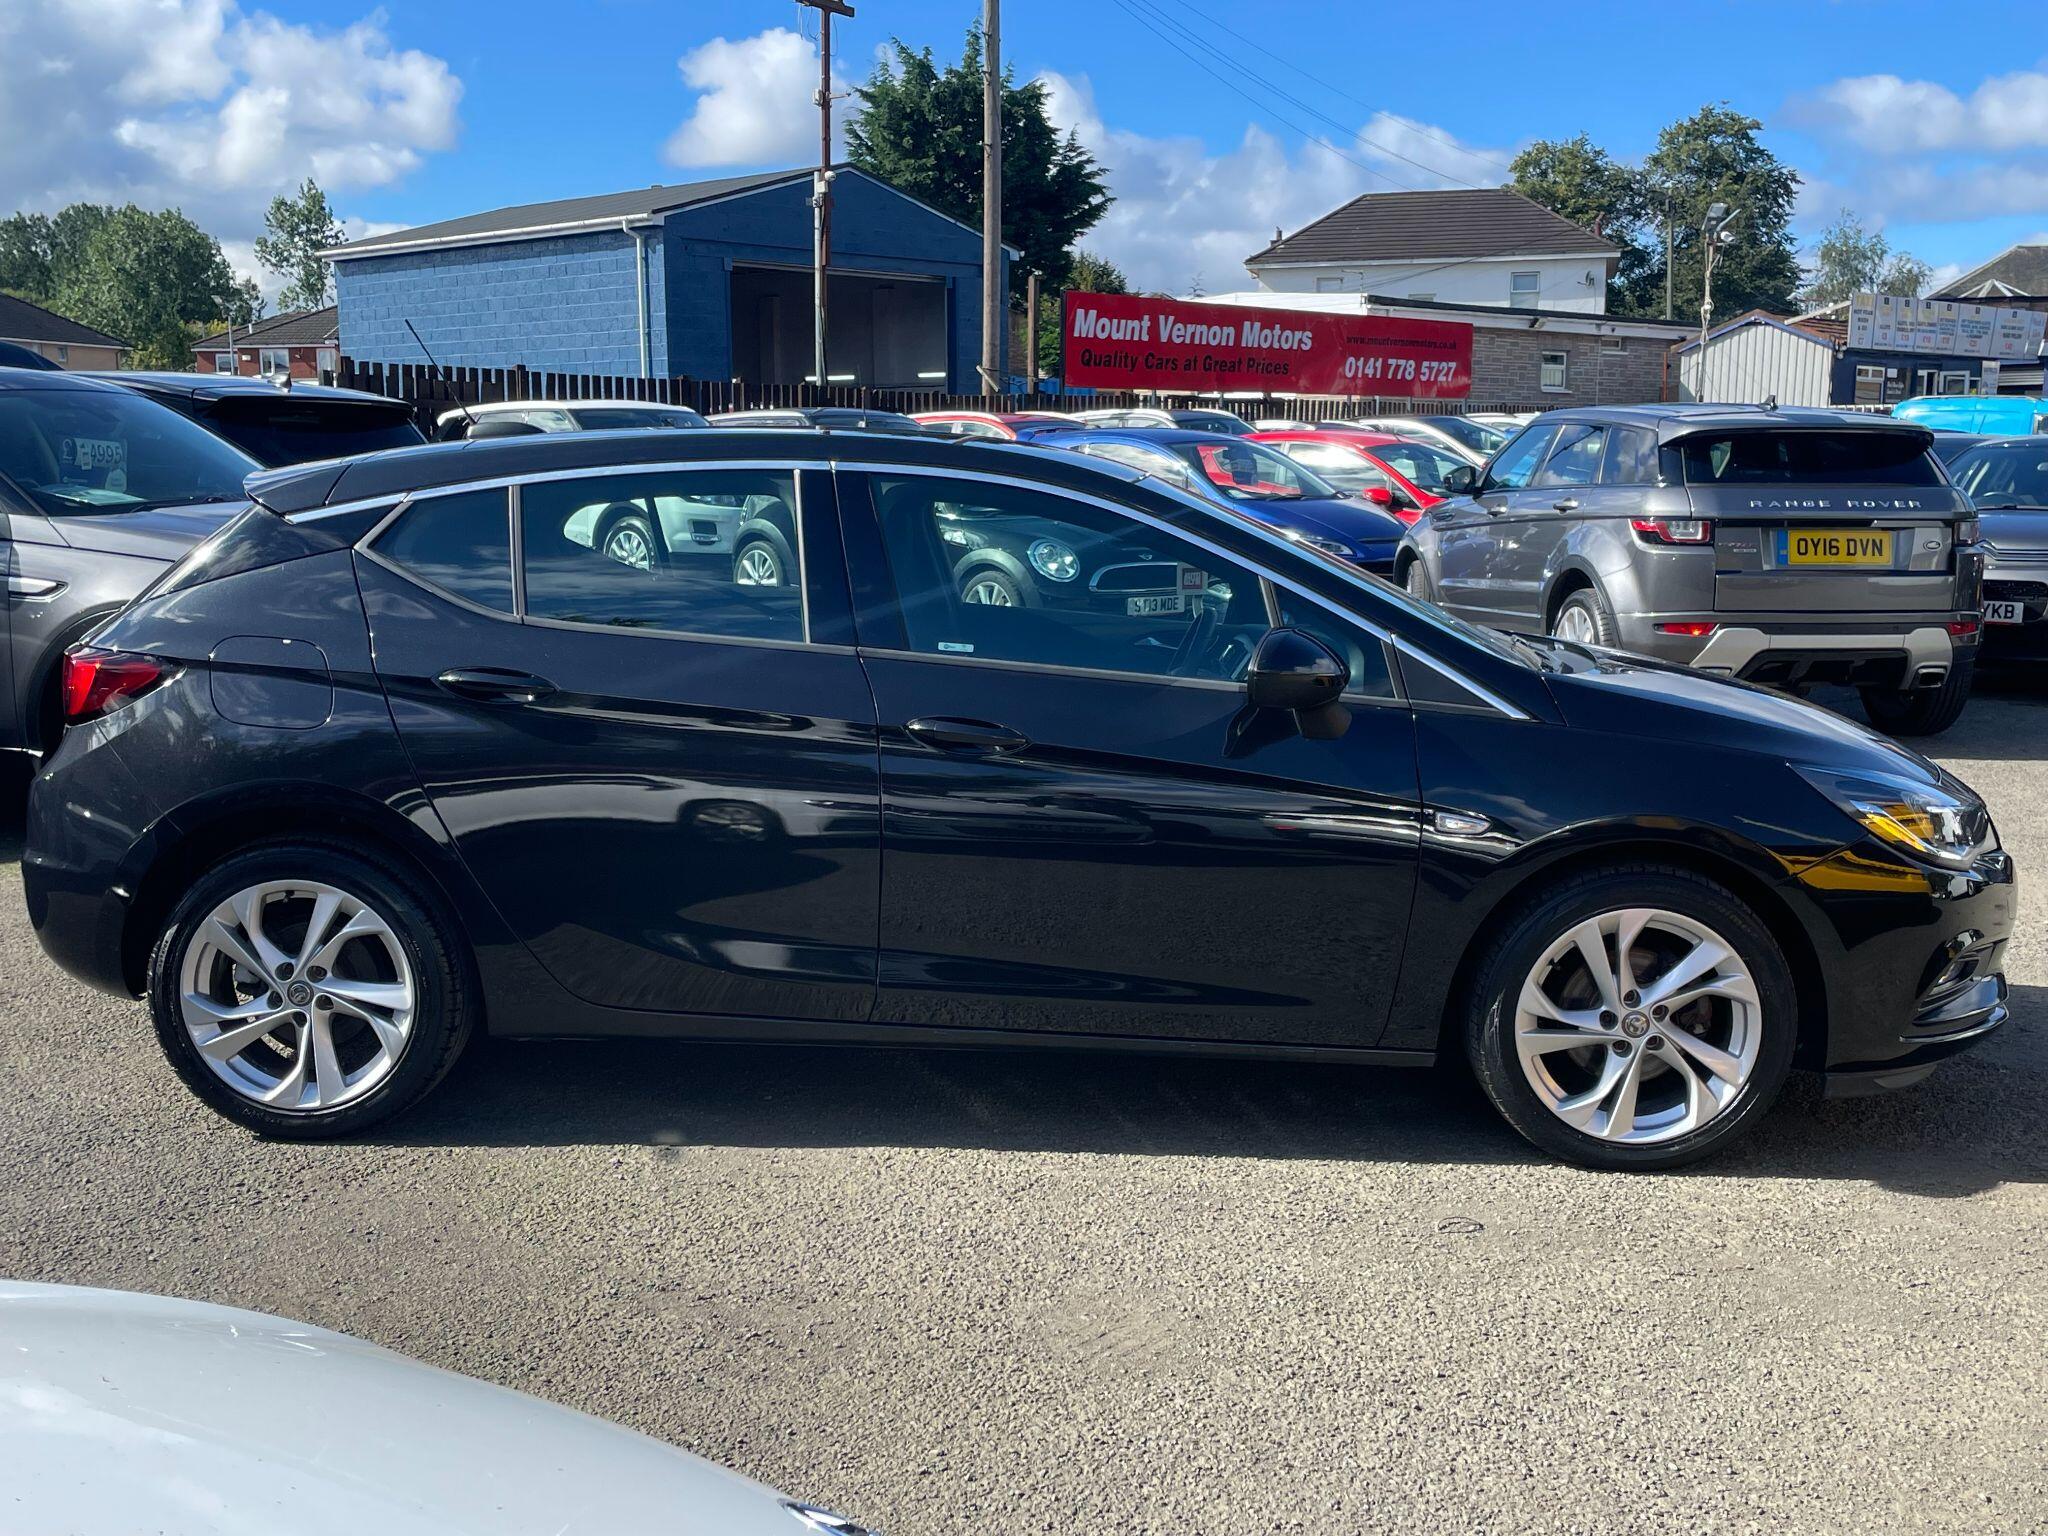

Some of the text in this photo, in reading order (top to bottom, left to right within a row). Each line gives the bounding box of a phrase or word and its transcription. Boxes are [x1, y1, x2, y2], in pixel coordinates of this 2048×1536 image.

[1073, 308, 1313, 351] Mount Vernon Motors
[1081, 348, 1289, 375] Quality Cars at Great Prices
[1344, 355, 1457, 382] 0141 778 5727
[1749, 499, 1923, 508] RANGE ROVER
[1796, 537, 1884, 558] OY16 DVN
